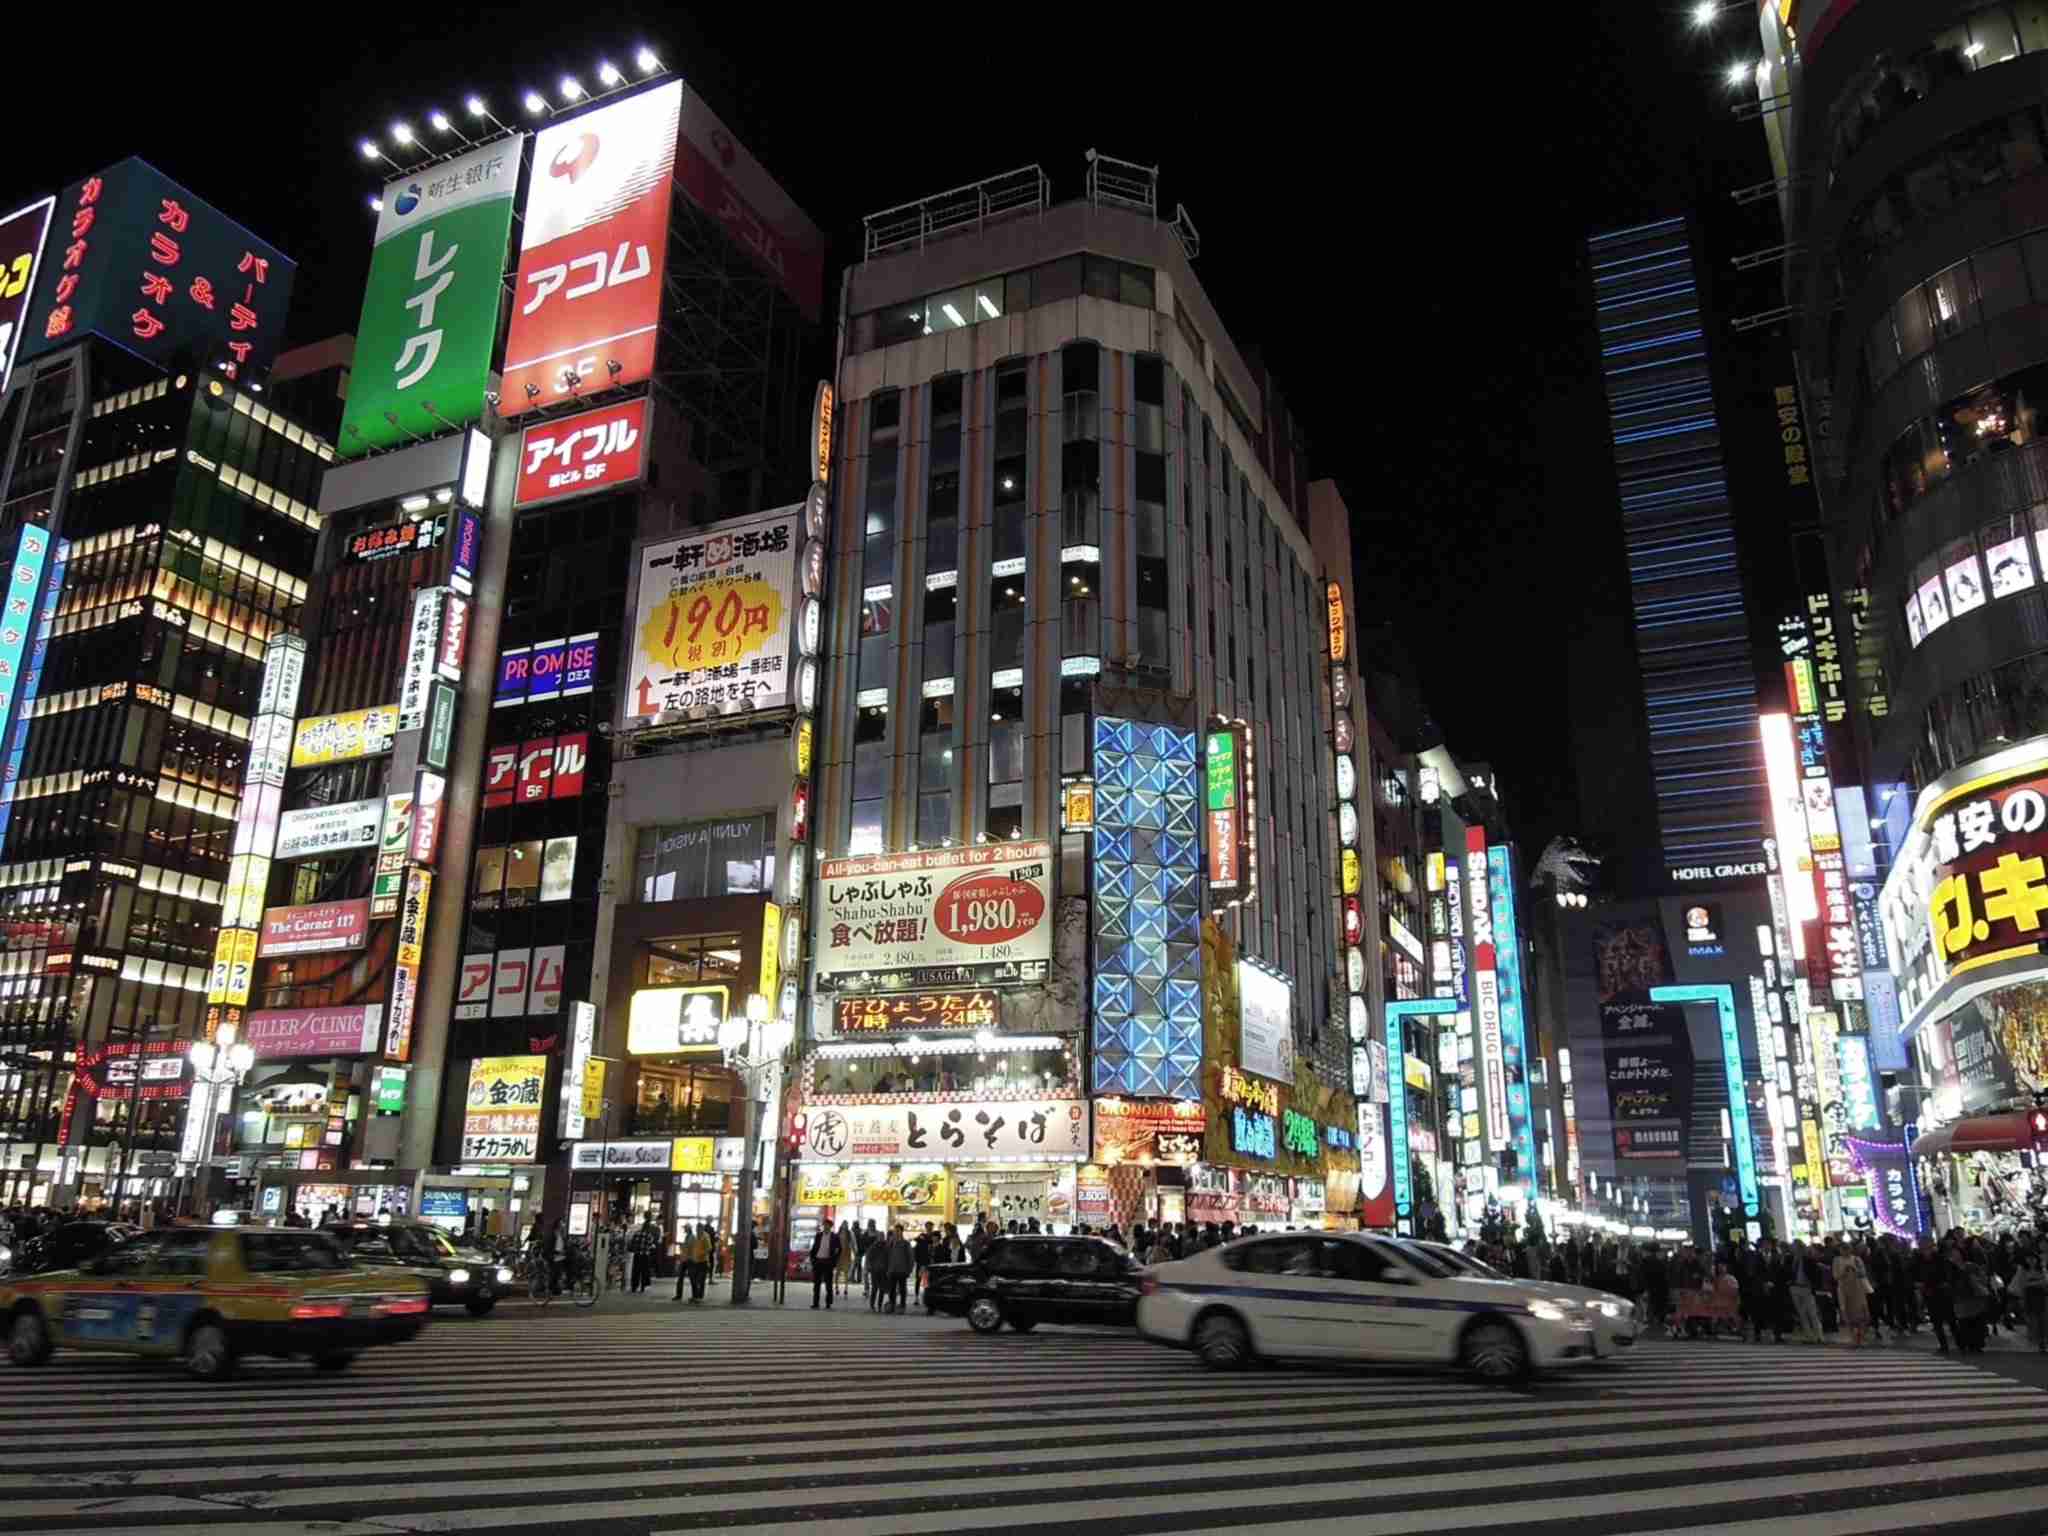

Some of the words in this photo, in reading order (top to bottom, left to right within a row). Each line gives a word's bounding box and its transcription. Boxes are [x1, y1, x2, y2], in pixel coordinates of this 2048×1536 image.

[132, 199, 189, 338] カラオケ
[523, 241, 651, 315] アコム
[394, 230, 458, 390] レイク
[526, 418, 639, 474] アイフル
[584, 463, 606, 480] 5F
[663, 590, 770, 648] 190円
[505, 646, 595, 681] PROMISE
[664, 681, 772, 711] 左の路地を右へ
[490, 744, 586, 785] アイフル
[526, 786, 542, 799] 5F
[968, 849, 987, 863] for
[993, 849, 1003, 861] 2
[1672, 866, 1714, 880] HOTEL
[829, 876, 933, 905] しゃぶしゃぶ
[400, 896, 420, 945] 金の蔵
[830, 918, 929, 948] 食べ放題!
[949, 898, 1016, 935] 1,980
[461, 957, 563, 1000] アコム
[1020, 962, 1046, 980] 5F
[841, 1001, 862, 1015] 7F
[1481, 980, 1495, 1006] BIC
[1484, 1011, 1500, 1054] DRUG
[489, 1077, 539, 1106] 金の蔵
[907, 1106, 1056, 1150] とらそば
